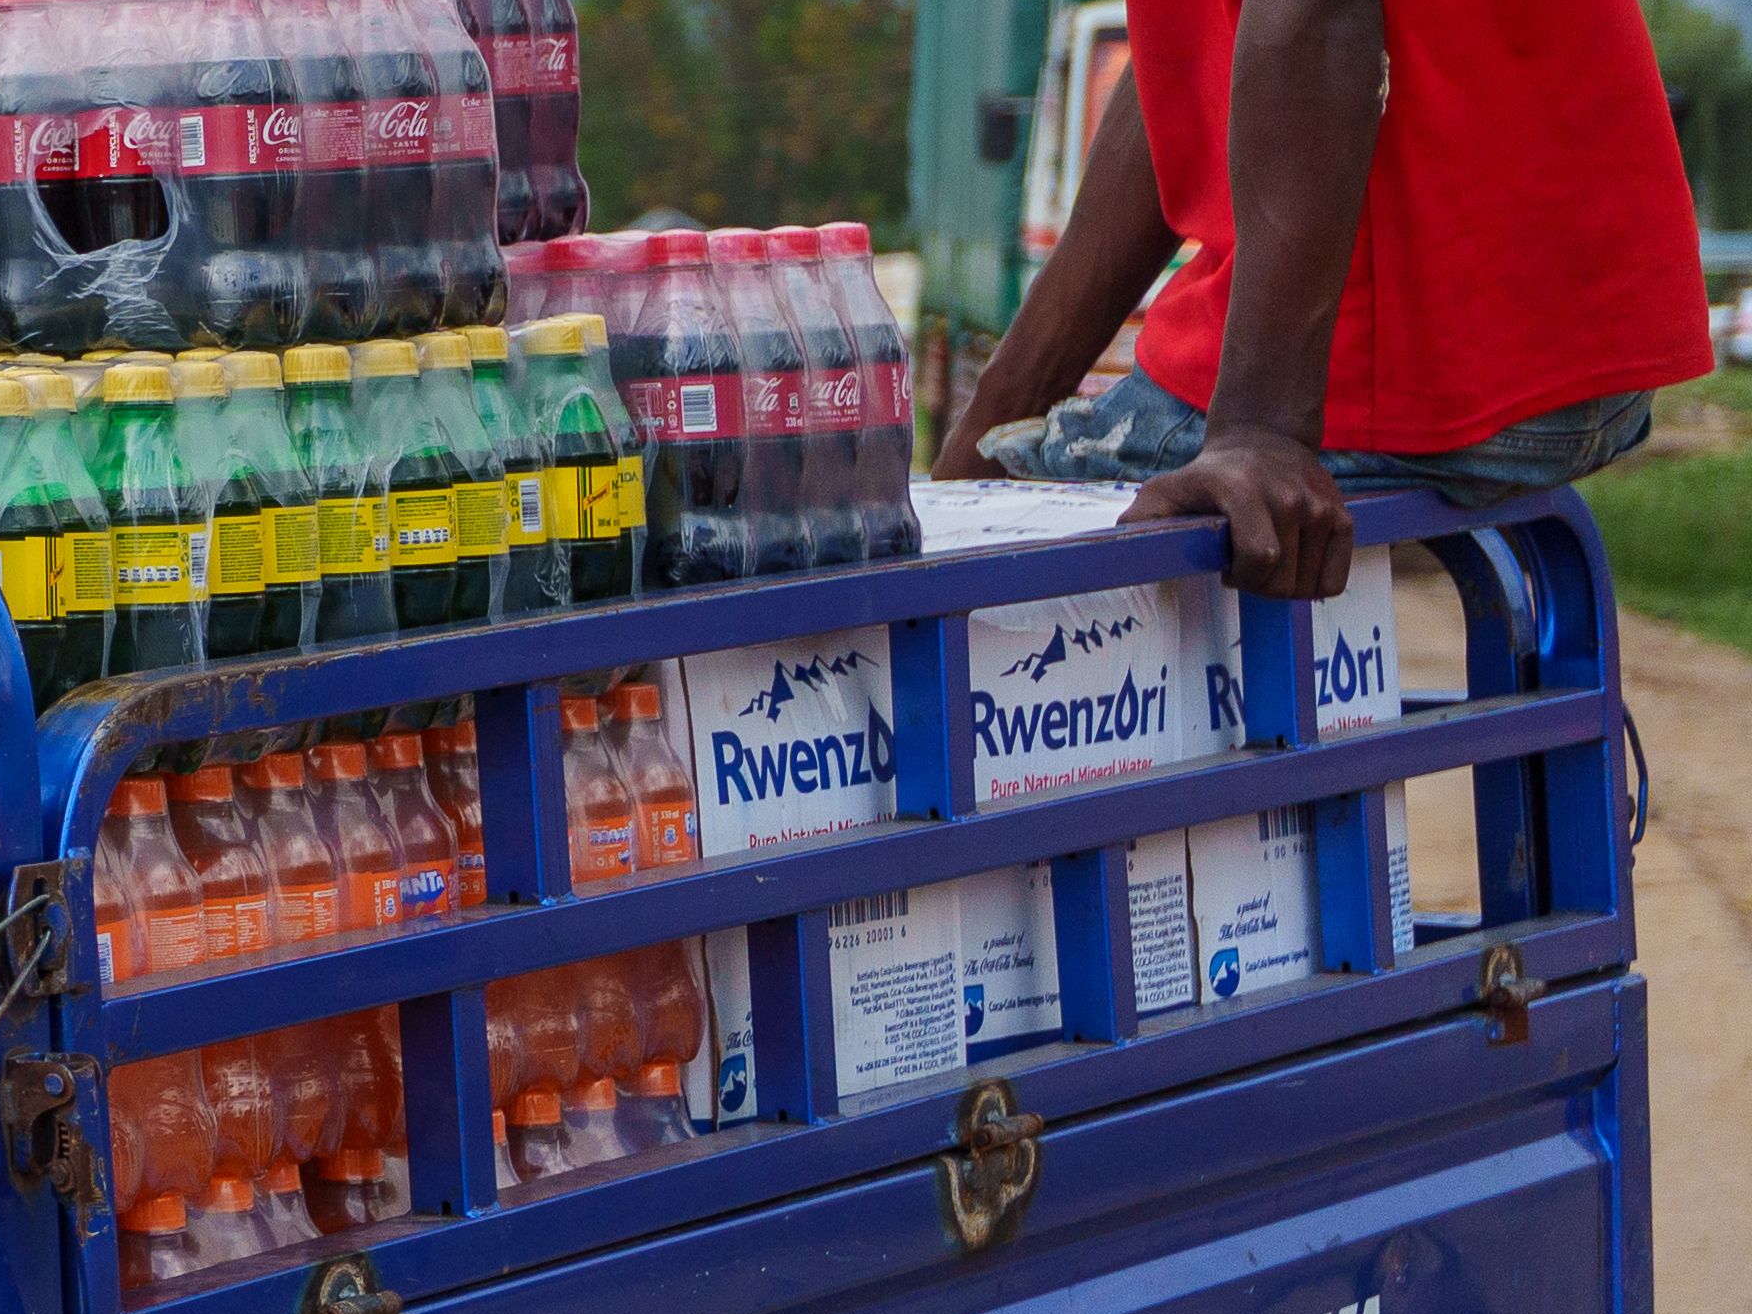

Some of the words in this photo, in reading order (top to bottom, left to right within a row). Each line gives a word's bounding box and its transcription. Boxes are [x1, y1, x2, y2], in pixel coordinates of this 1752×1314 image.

[971, 663, 1167, 759] Rwenzori
[711, 696, 895, 806] Rwenzo
[991, 778, 1020, 800] Pure
[1024, 767, 1075, 794] Natural
[399, 871, 445, 896] ANTA
